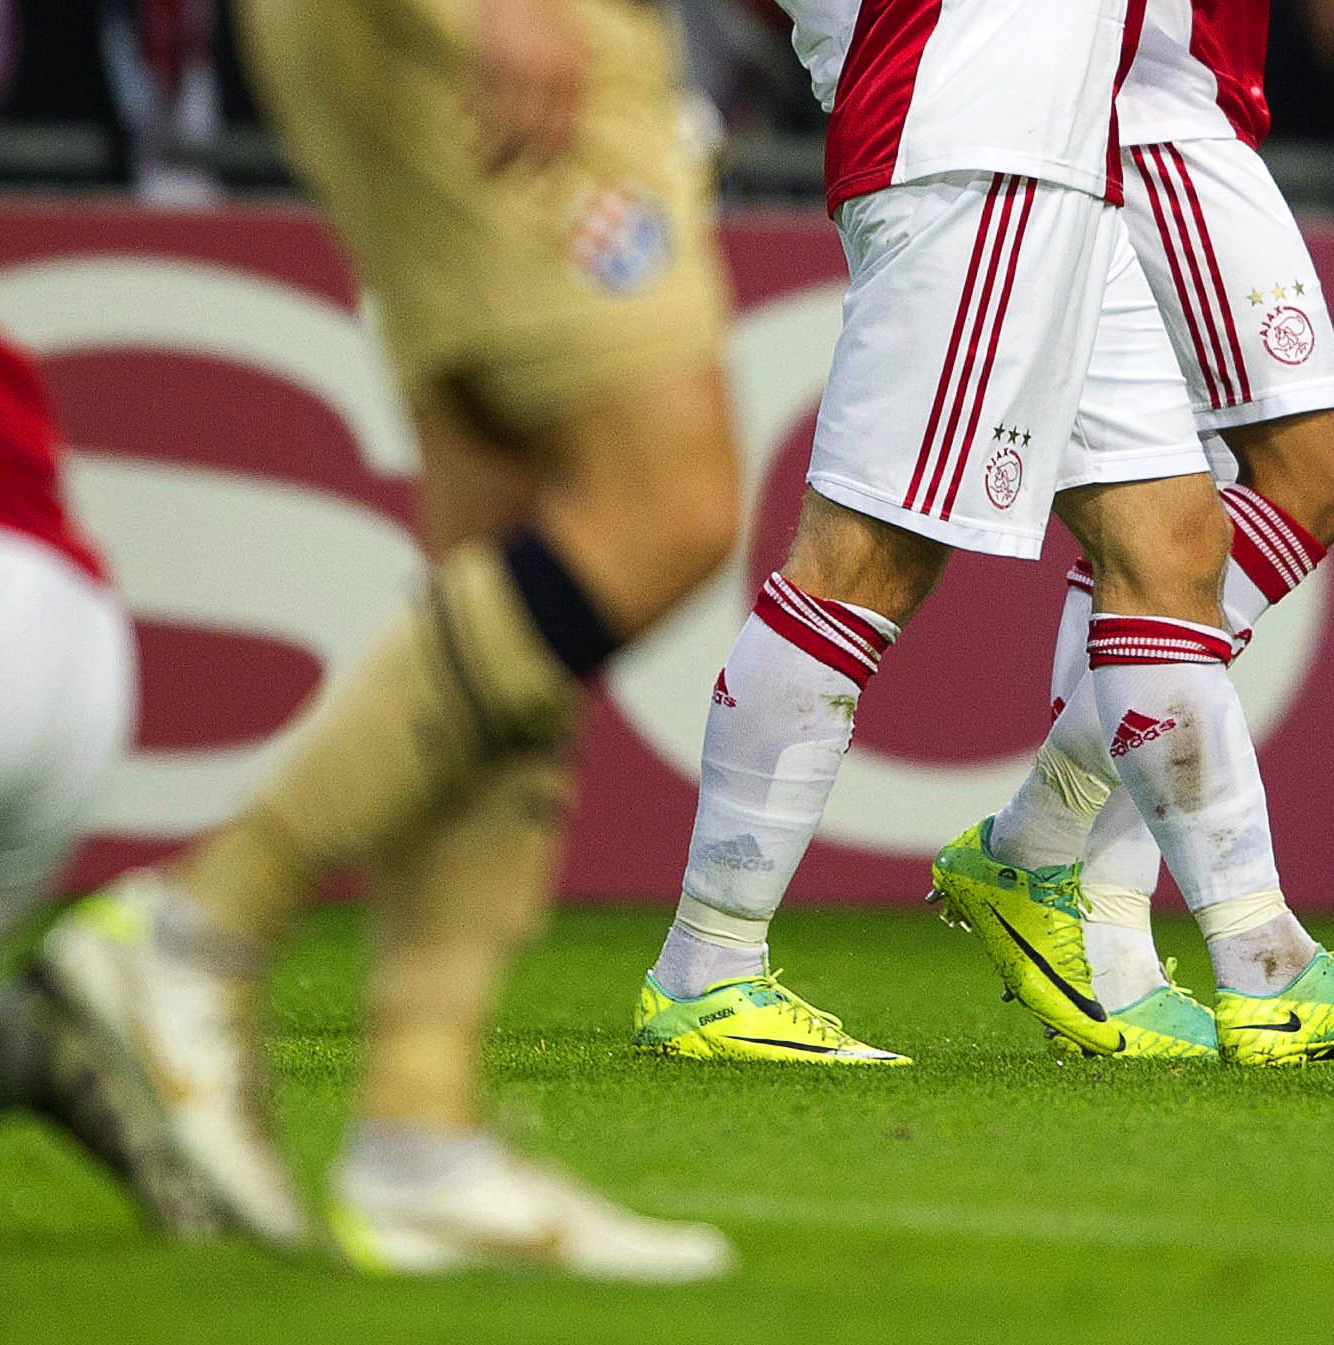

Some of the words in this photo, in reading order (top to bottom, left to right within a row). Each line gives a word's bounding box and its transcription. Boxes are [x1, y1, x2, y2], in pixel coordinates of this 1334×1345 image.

[1259, 305, 1283, 338] AJAX
[986, 447, 1009, 473] AJAX
[1109, 718, 1177, 758] adidas
[698, 1006, 735, 1027] ERIKSEN
